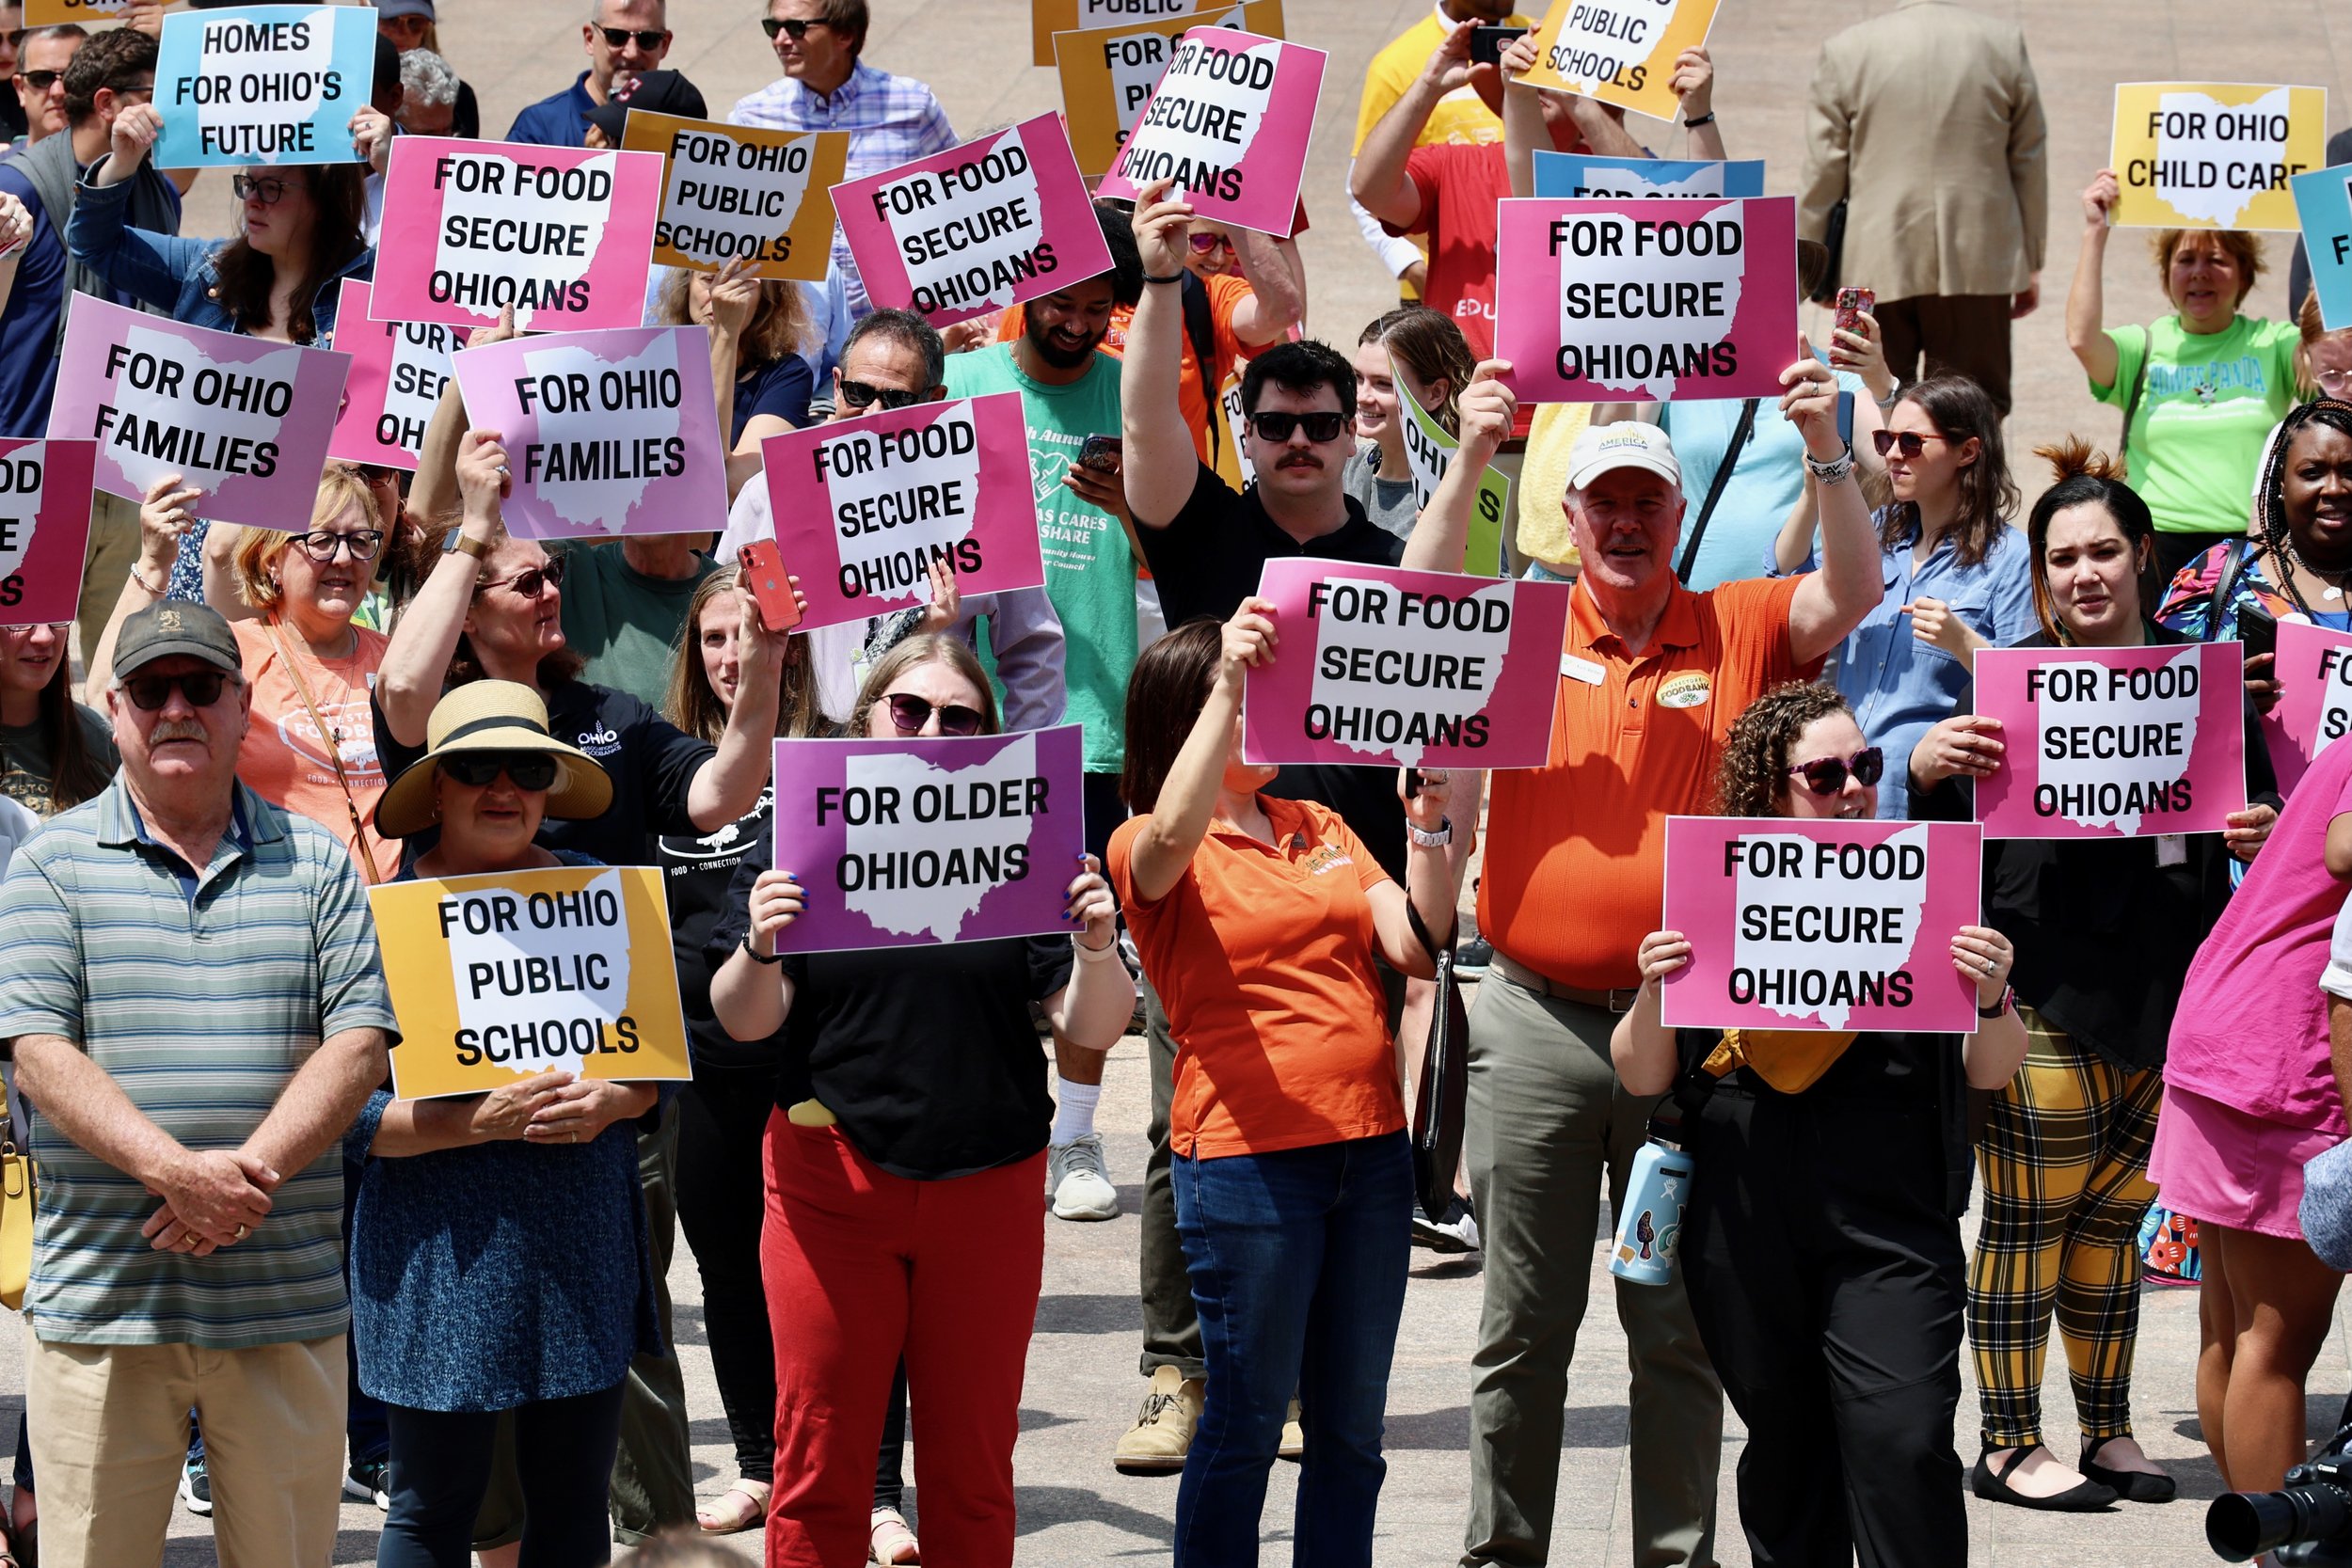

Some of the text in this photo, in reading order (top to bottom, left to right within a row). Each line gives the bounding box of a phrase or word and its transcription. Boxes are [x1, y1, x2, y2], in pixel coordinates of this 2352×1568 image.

[204, 23, 310, 54] HOMES
[1569, 9, 1646, 44] PUBLIC
[1103, 37, 1164, 70] FOR
[1194, 46, 1274, 90] FOOD
[1545, 44, 1646, 91] SCHOOLS
[176, 71, 342, 105] FOR OHIO'S
[201, 122, 314, 155] FUTURE
[1144, 96, 1247, 145] SECURE
[2149, 112, 2289, 142] FOR OHIO
[669, 133, 807, 174] FOR OHIO
[1120, 148, 1243, 201] OHIOANS
[2128, 159, 2217, 188] CHILD
[435, 158, 612, 202] FOR FOOD
[676, 180, 785, 218] PUBLIC
[871, 146, 1027, 222] FOR FOOD
[444, 214, 588, 257] SECURE
[652, 220, 792, 262] SCHOOLS
[902, 197, 1037, 267] SECURE
[1549, 220, 1742, 257] FOR FOOD
[428, 270, 590, 312] OHIOANS
[912, 242, 1059, 316] OHIOANS
[1566, 281, 1724, 319] SECURE
[104, 343, 294, 418] FOR OHIO
[1555, 341, 1738, 381] OHIOANS
[515, 368, 682, 415] FOR OHIO
[93, 404, 280, 479] FAMILIES
[524, 436, 686, 484] FAMILIES
[812, 420, 975, 483] FOR FOOD
[838, 480, 965, 538] SECURE
[1058, 511, 1108, 531] CARES
[1041, 525, 1090, 545] SHARE
[839, 539, 983, 600] OHIOANS
[1307, 582, 1510, 634] FOR FOOD
[1320, 645, 1486, 691] SECURE
[2027, 664, 2199, 703] FOR FOOD
[1660, 683, 1709, 701] FOODBANK
[578, 730, 617, 744] OHIO
[1304, 704, 1490, 749] OHIOANS
[2044, 721, 2184, 760] SECURE
[817, 775, 1052, 827] FOR OLDER
[2033, 777, 2192, 817] OHIOANS
[671, 865, 688, 877] FOOD
[834, 843, 1031, 894] OHIOANS
[1724, 840, 1925, 880] FOR FOOD
[437, 889, 618, 939] FOR OHIO
[1741, 904, 1904, 944] SECURE
[469, 953, 610, 1000] PUBLIC
[1728, 967, 1914, 1008] OHIOANS
[454, 1016, 640, 1067] SCHOOLS
